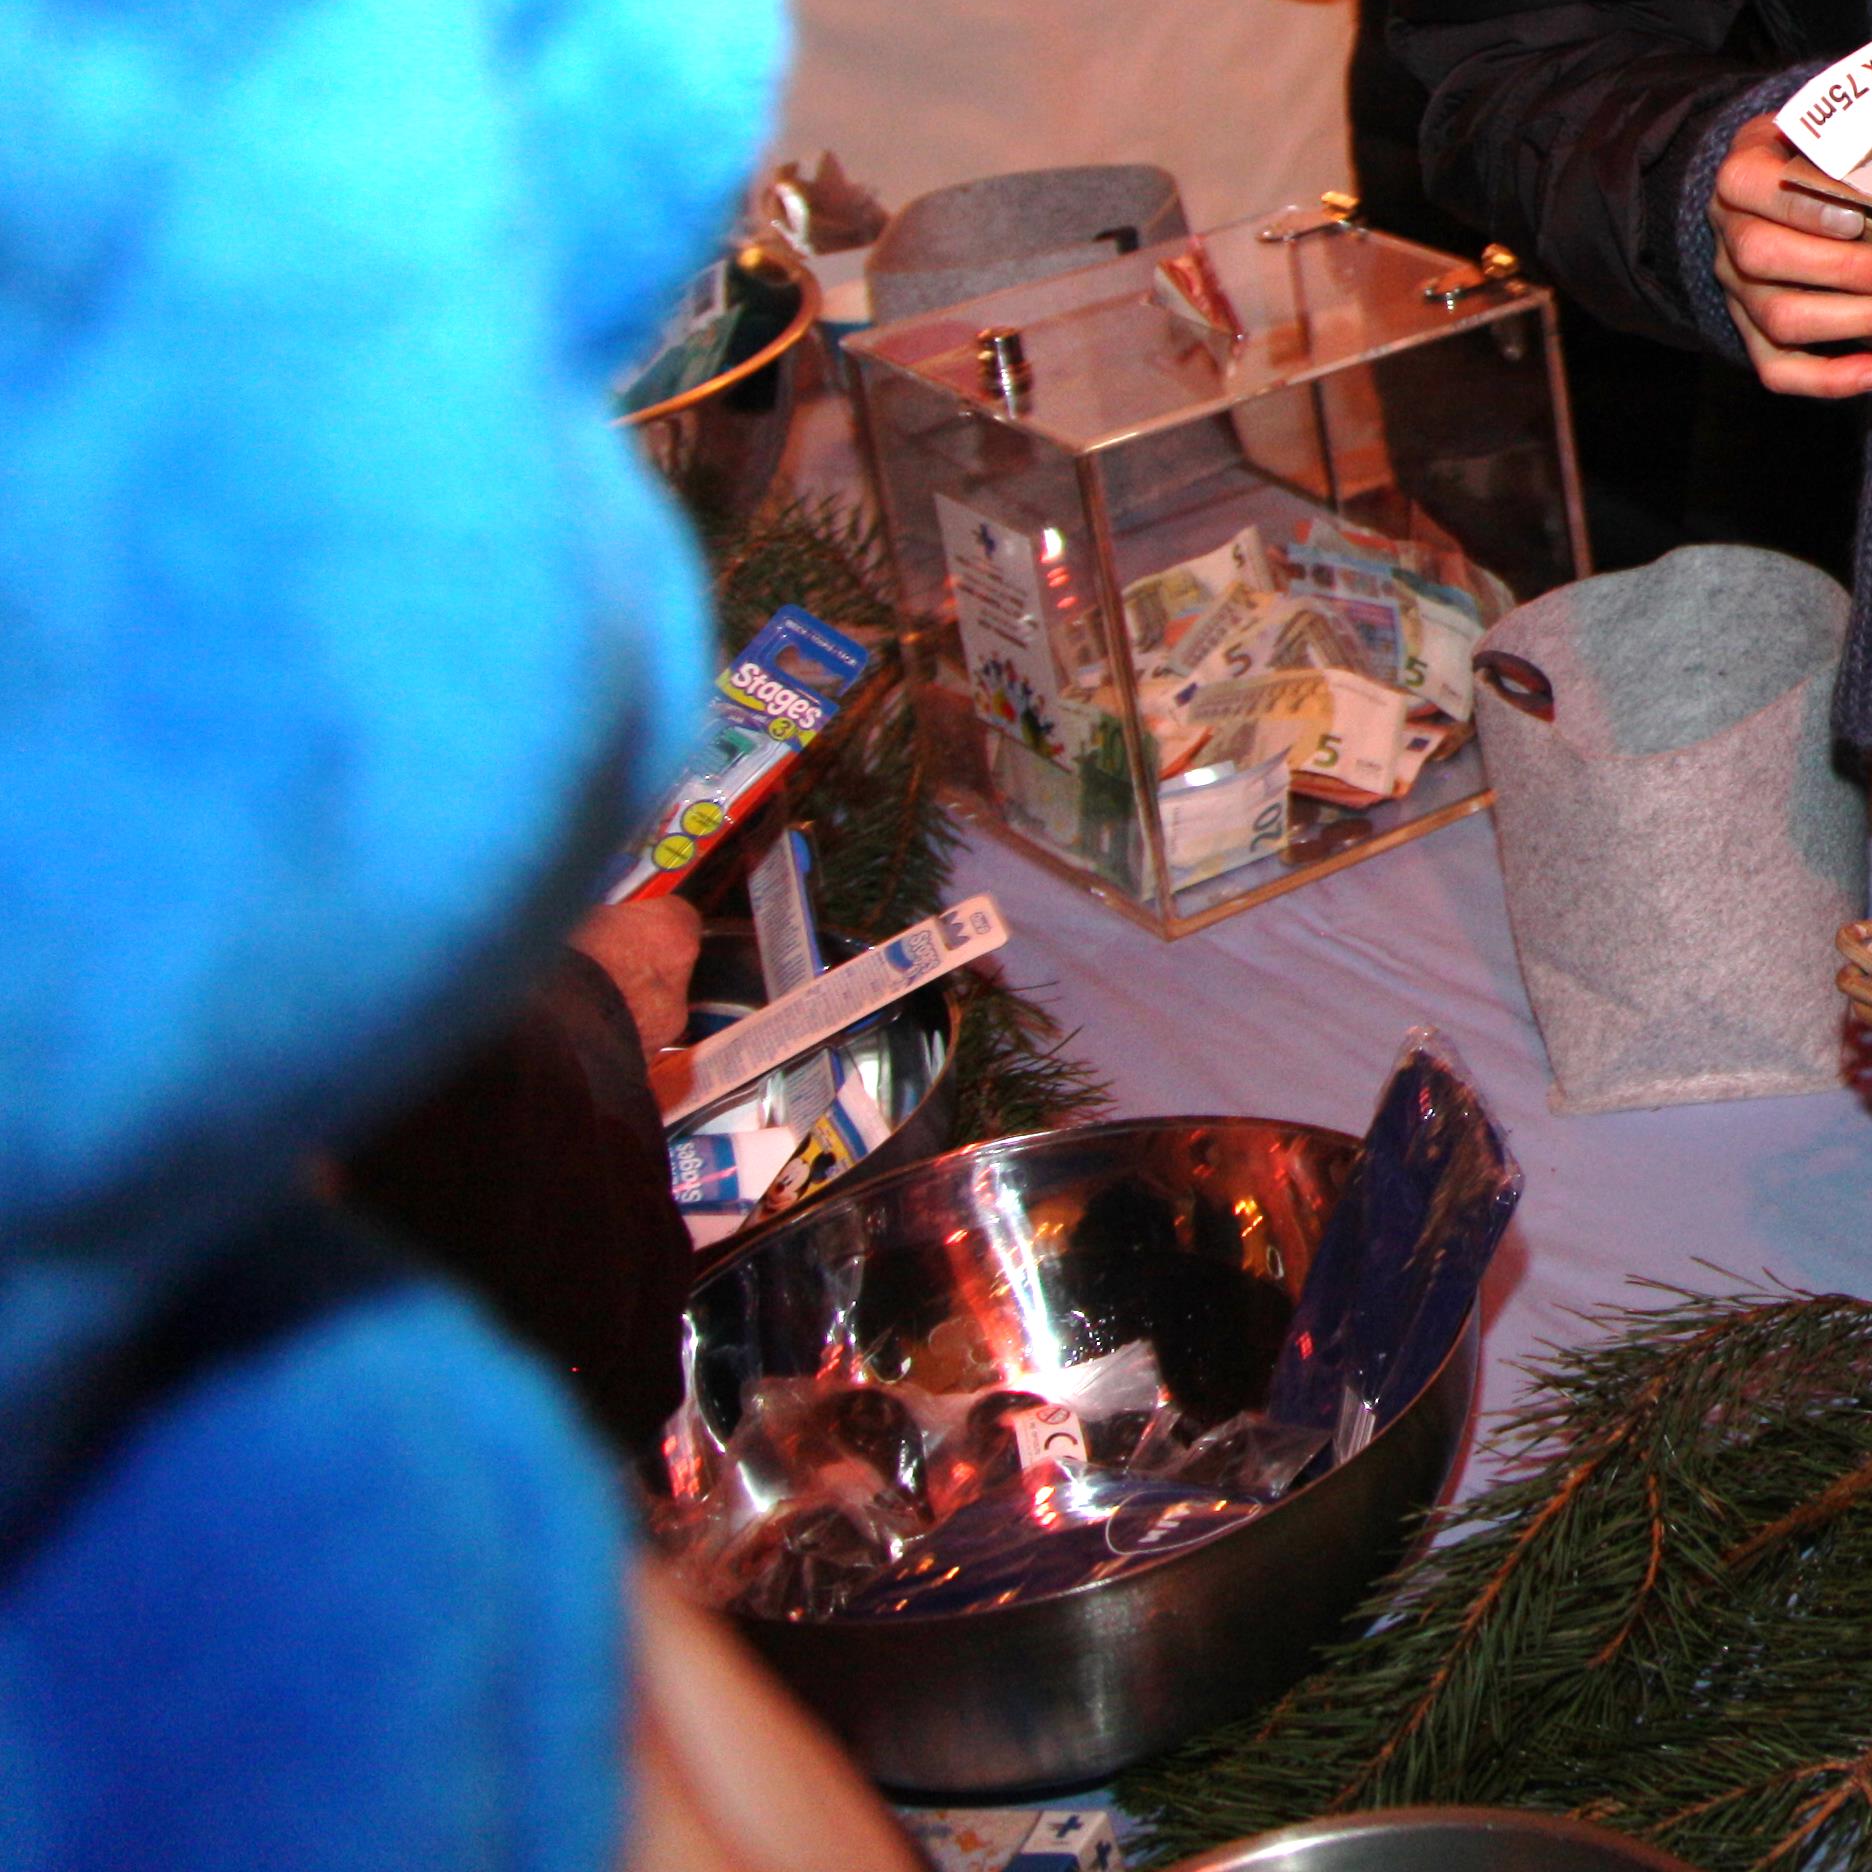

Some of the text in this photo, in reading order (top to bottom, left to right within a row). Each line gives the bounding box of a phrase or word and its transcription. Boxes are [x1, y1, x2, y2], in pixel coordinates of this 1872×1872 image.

[1799, 73, 1870, 140] 75ml
[1223, 643, 1253, 677] 5
[1404, 655, 1430, 689] 5
[730, 662, 823, 729] Stages
[772, 719, 791, 737] 3
[1313, 734, 1343, 769] 5
[1250, 802, 1283, 853] 20
